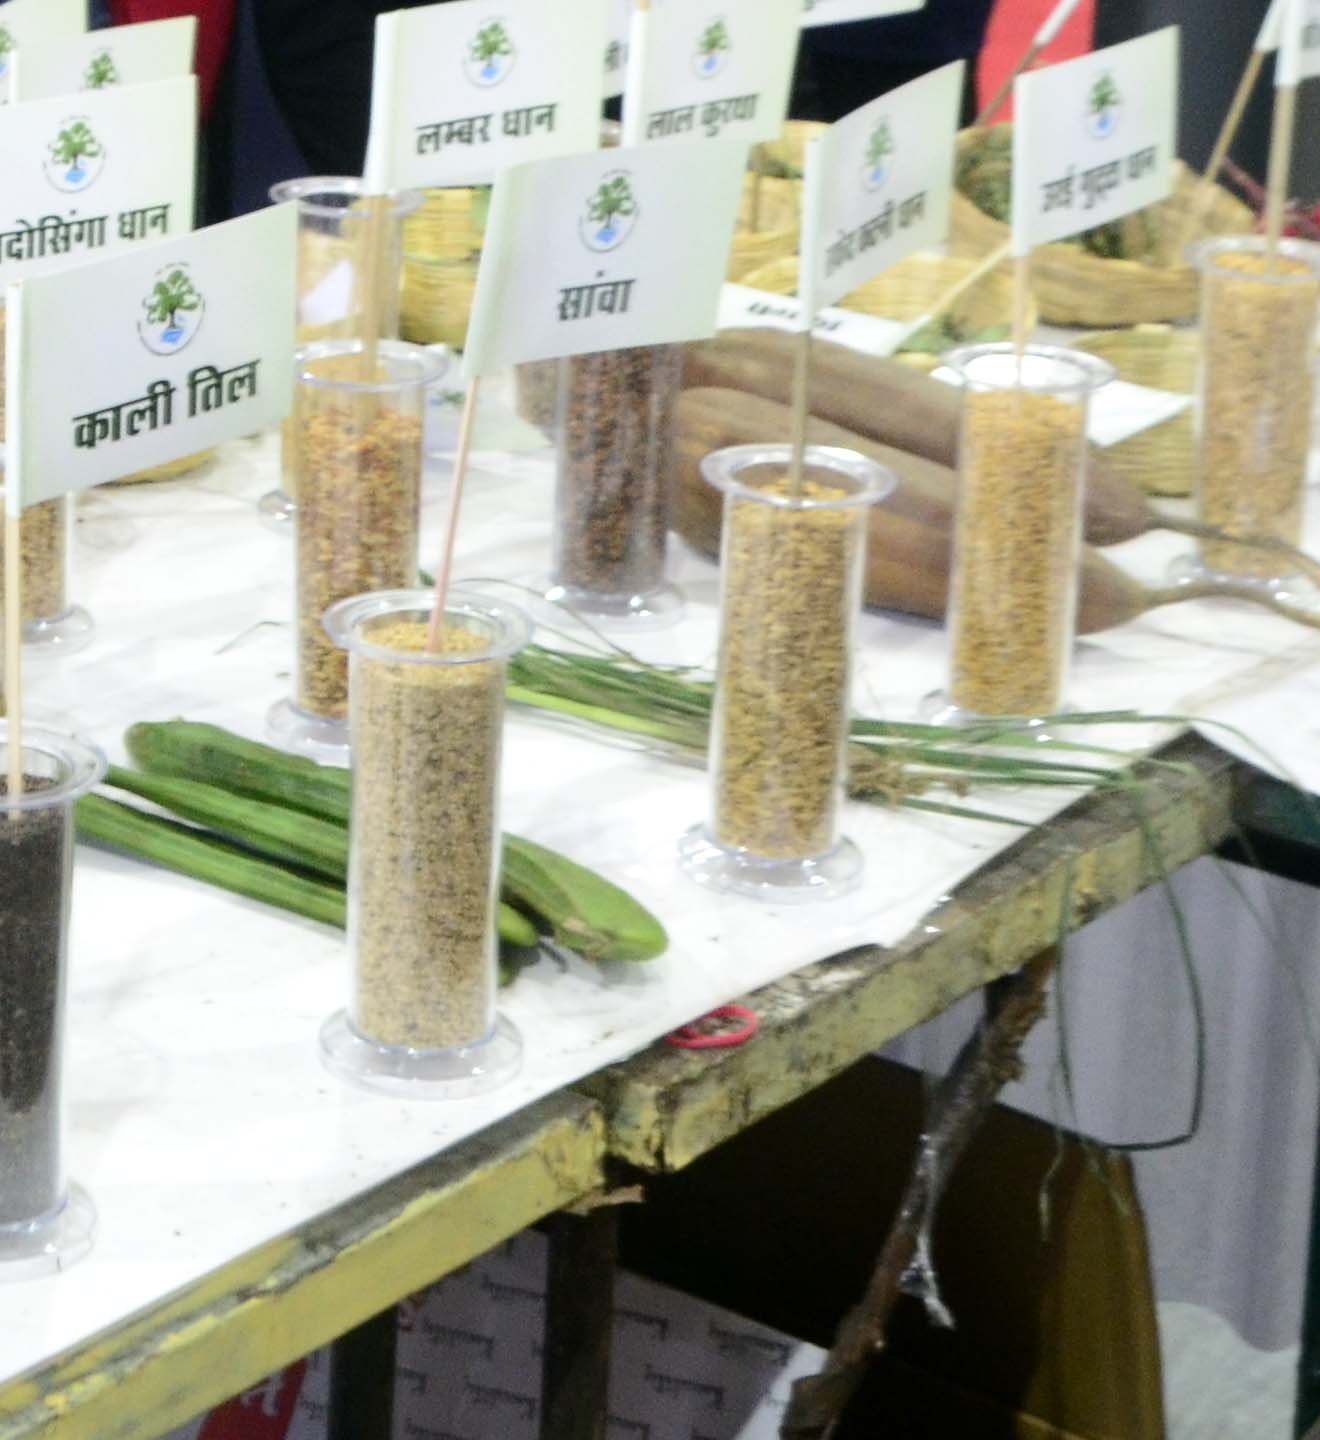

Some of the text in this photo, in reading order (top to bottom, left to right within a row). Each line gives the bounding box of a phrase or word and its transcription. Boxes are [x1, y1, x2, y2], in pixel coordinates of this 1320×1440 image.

[502, 101, 558, 137] धान
[646, 104, 697, 140] लाल
[117, 203, 171, 240] धान
[557, 270, 637, 322] सांवा
[71, 358, 262, 451] काली तिल
